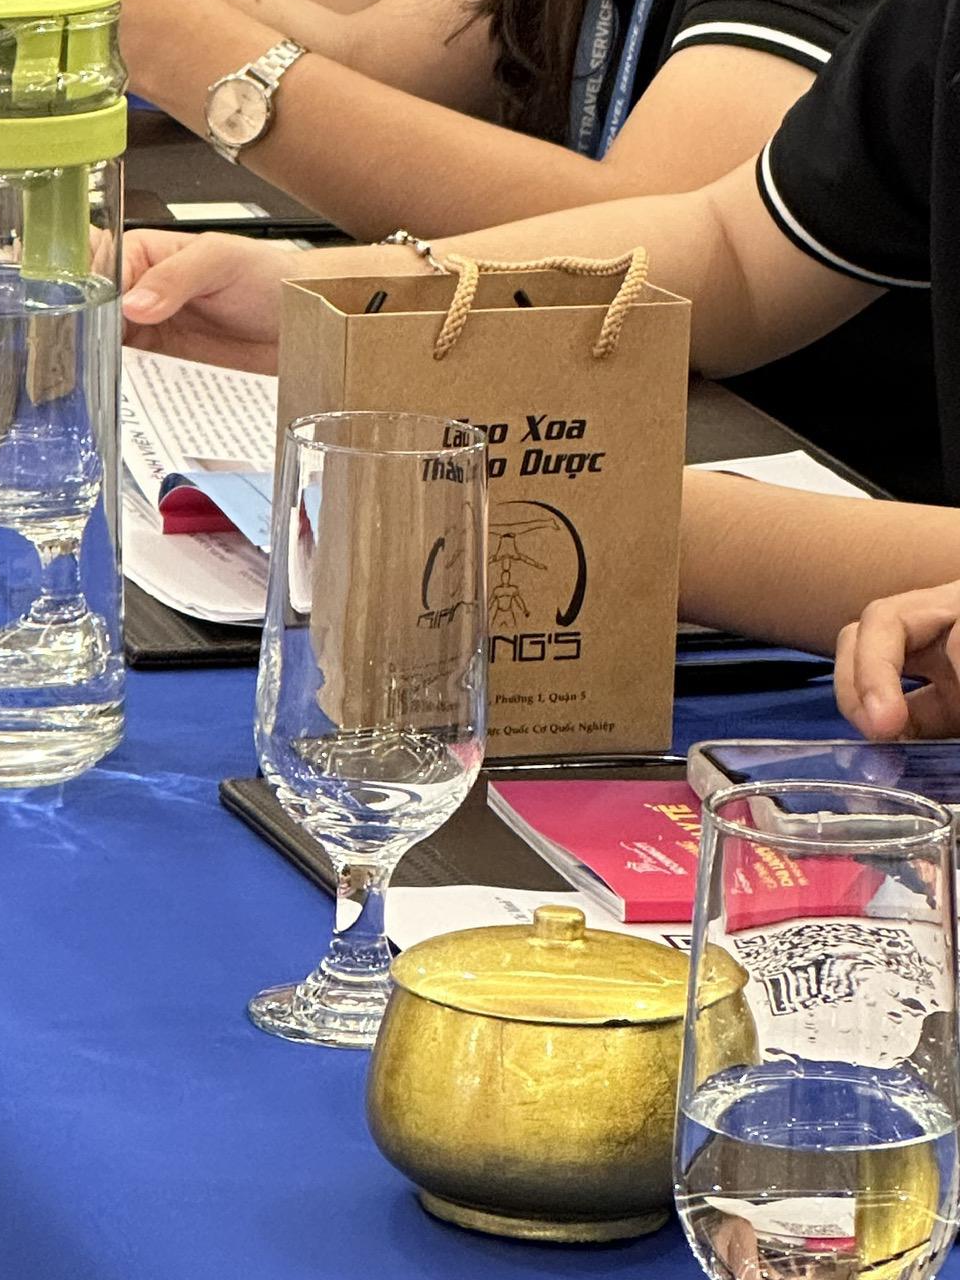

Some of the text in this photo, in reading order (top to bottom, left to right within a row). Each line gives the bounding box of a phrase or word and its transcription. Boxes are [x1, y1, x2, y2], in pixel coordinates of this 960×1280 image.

[590, 0, 613, 70] SERVICE
[580, 74, 603, 136] TRAVEL
[607, 98, 625, 151] RAVEL
[520, 415, 587, 443] Xoa
[520, 448, 606, 479] Dược
[548, 692, 577, 704] Quận
